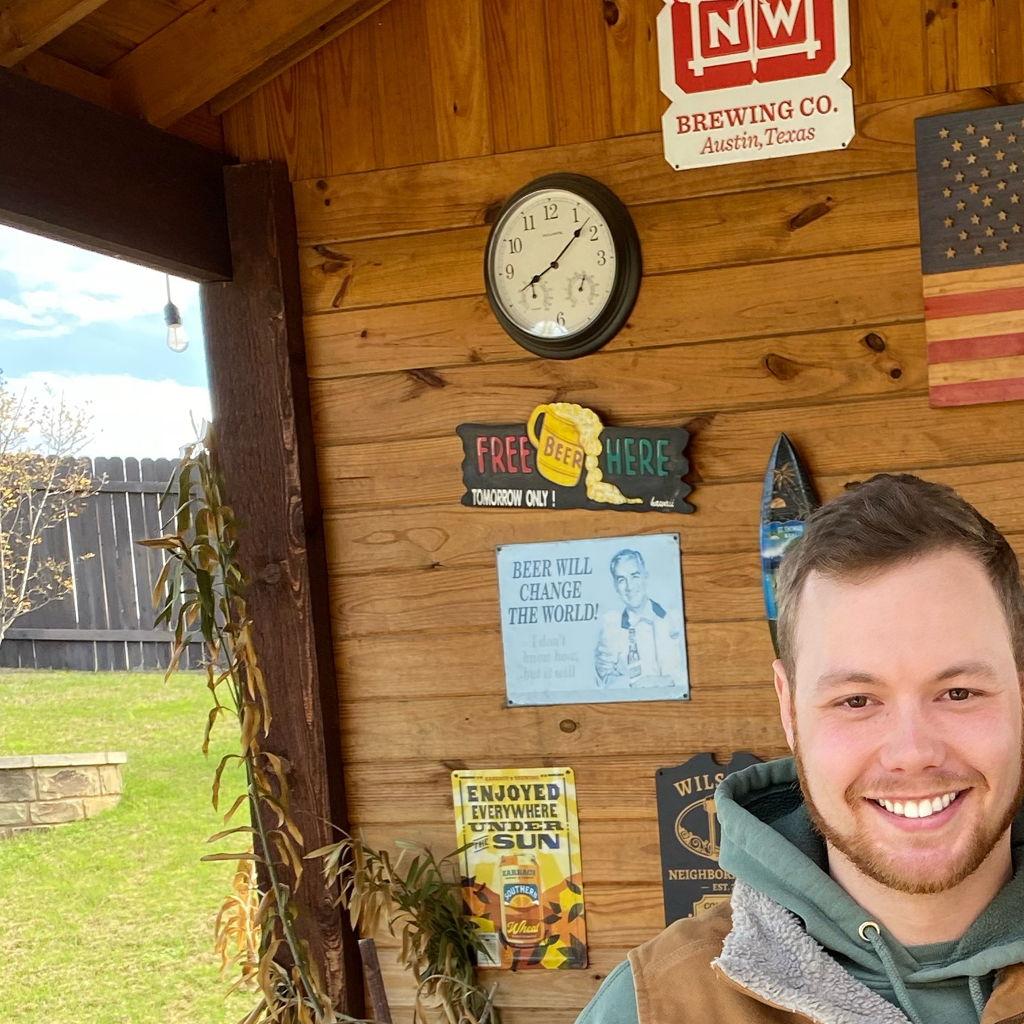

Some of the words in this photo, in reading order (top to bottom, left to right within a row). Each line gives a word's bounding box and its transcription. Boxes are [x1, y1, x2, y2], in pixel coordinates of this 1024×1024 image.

[676, 100, 795, 134] BREWING
[800, 95, 839, 117] CO.
[543, 203, 559, 220] 12
[572, 208, 580, 224] 1
[522, 214, 537, 231] 11
[588, 225, 599, 242] 2
[508, 237, 523, 254] 10
[597, 249, 607, 266] 3
[505, 263, 515, 280] 9
[556, 311, 566, 327] 6
[476, 435, 534, 474] FREE
[543, 435, 582, 468] BEER
[605, 437, 670, 477] HERE
[471, 489, 523, 507] TOMORROW
[526, 489, 549, 508] ONLY
[512, 560, 552, 579] BEER
[555, 556, 593, 576] WILL
[519, 581, 582, 601] CHANGE
[508, 606, 538, 625] THE
[542, 603, 600, 624] WORLD!
[467, 783, 560, 802] ENJOYED
[673, 773, 725, 797] WILS
[471, 803, 557, 820] EVERYWHERE
[468, 820, 564, 833] UNDER
[492, 833, 560, 850] SUN
[668, 868, 736, 881] NEIGHBOR
